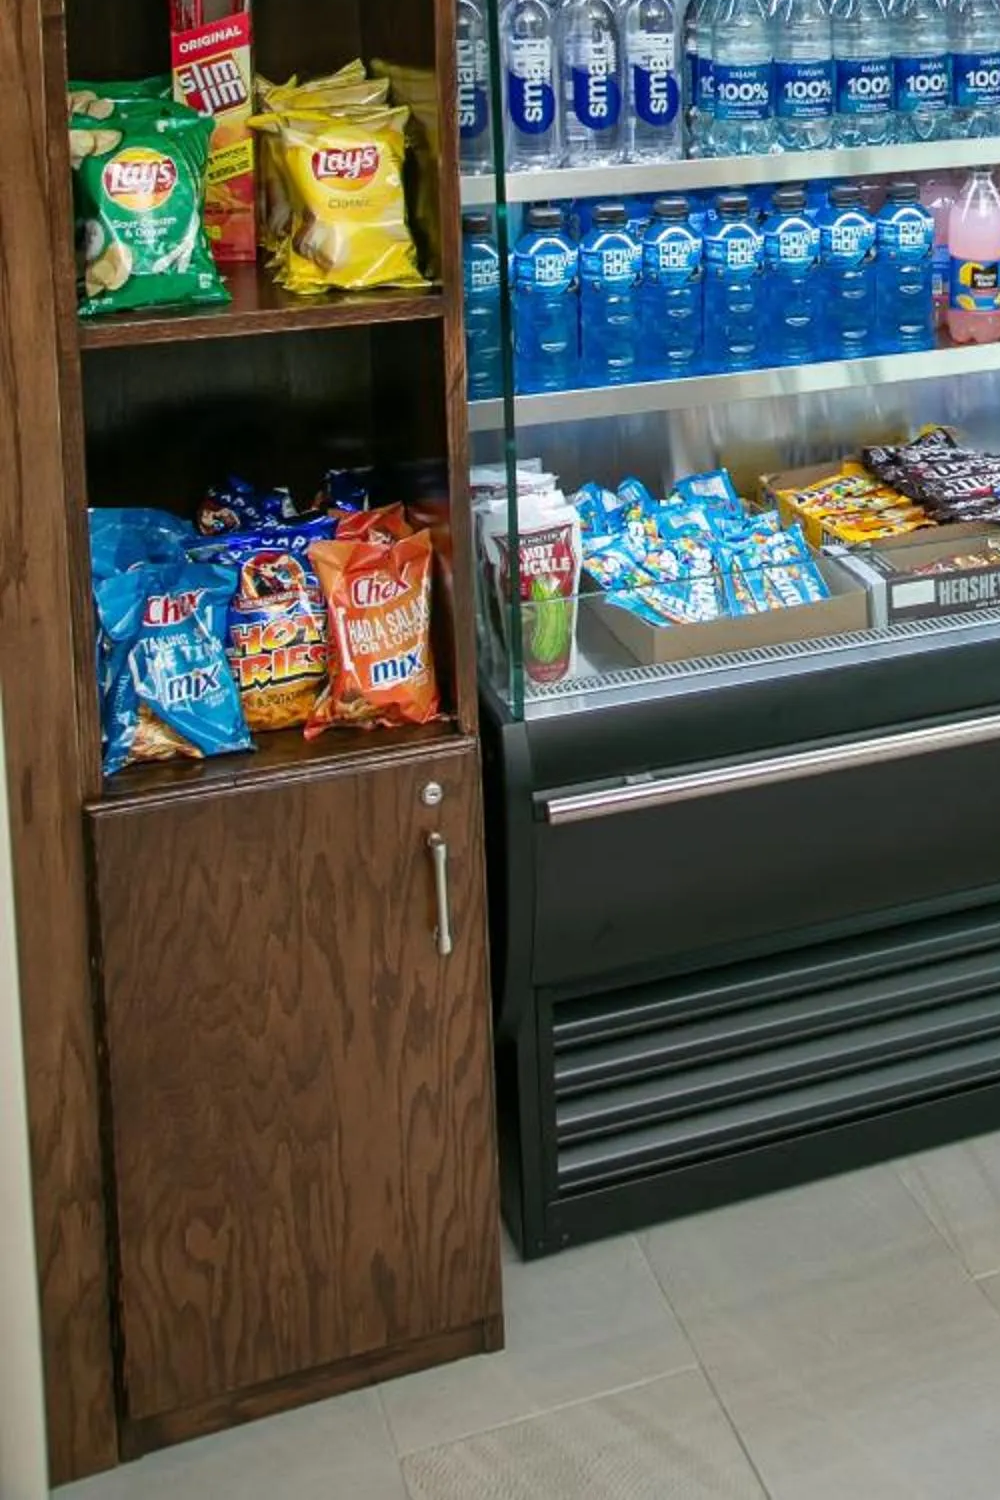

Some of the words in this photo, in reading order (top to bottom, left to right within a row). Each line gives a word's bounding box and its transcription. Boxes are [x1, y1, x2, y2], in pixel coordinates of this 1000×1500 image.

[179, 25, 242, 53] ORIGINAL
[717, 80, 768, 101] 100%
[784, 80, 832, 100] 100%
[109, 161, 173, 193] Lay's
[316, 146, 376, 179] Lay's
[519, 556, 570, 576] ICKLE
[353, 563, 411, 607] Chex
[231, 613, 327, 655] HOT
[372, 647, 425, 685] mix
[169, 664, 219, 701] mix
